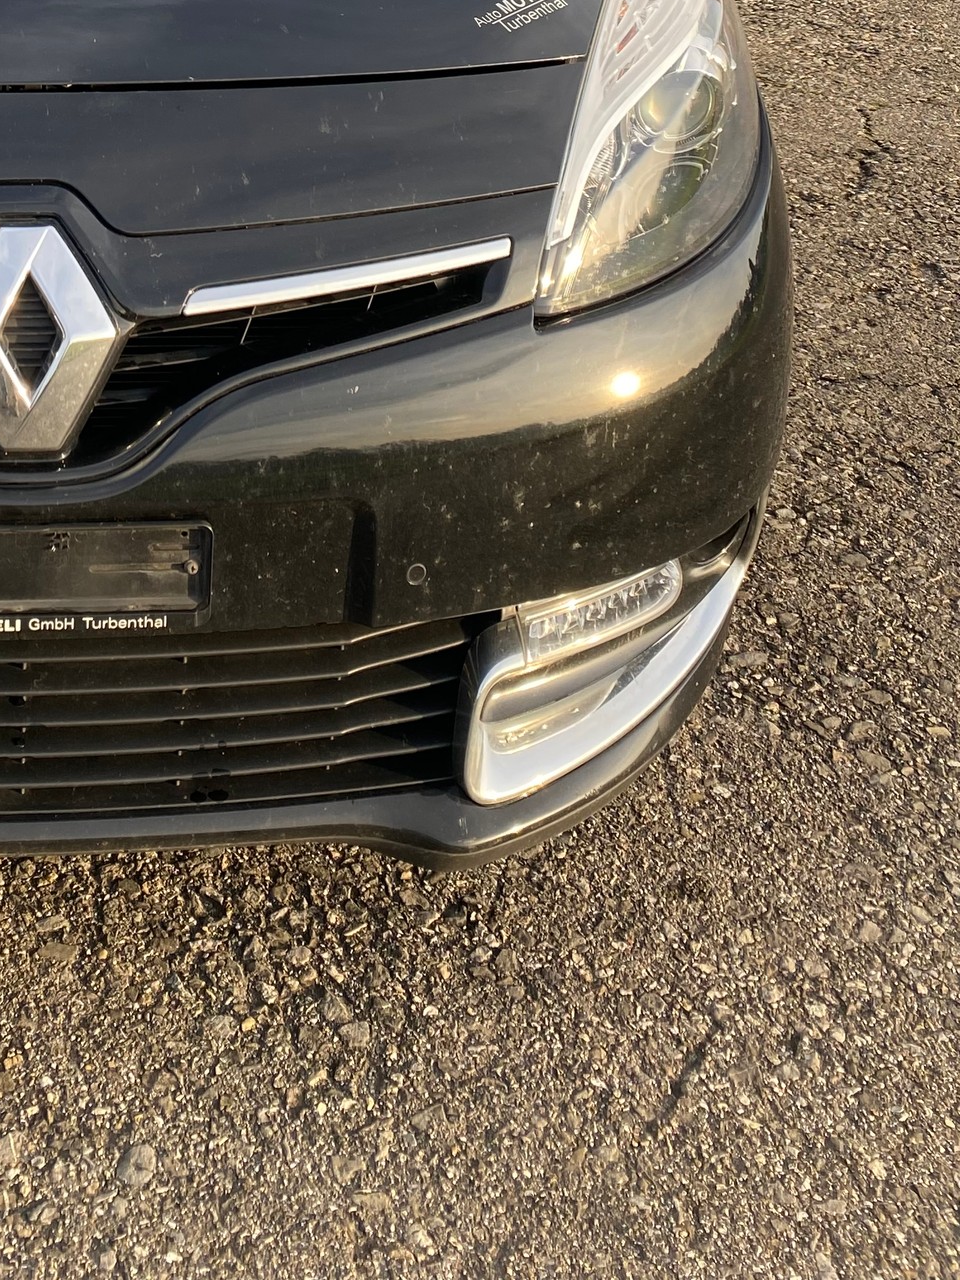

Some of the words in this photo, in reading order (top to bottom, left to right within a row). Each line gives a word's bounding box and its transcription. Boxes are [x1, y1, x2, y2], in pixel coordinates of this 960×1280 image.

[473, 10, 502, 28] Auto
[28, 617, 75, 632] GmbH
[82, 615, 168, 631] Turbenthal
